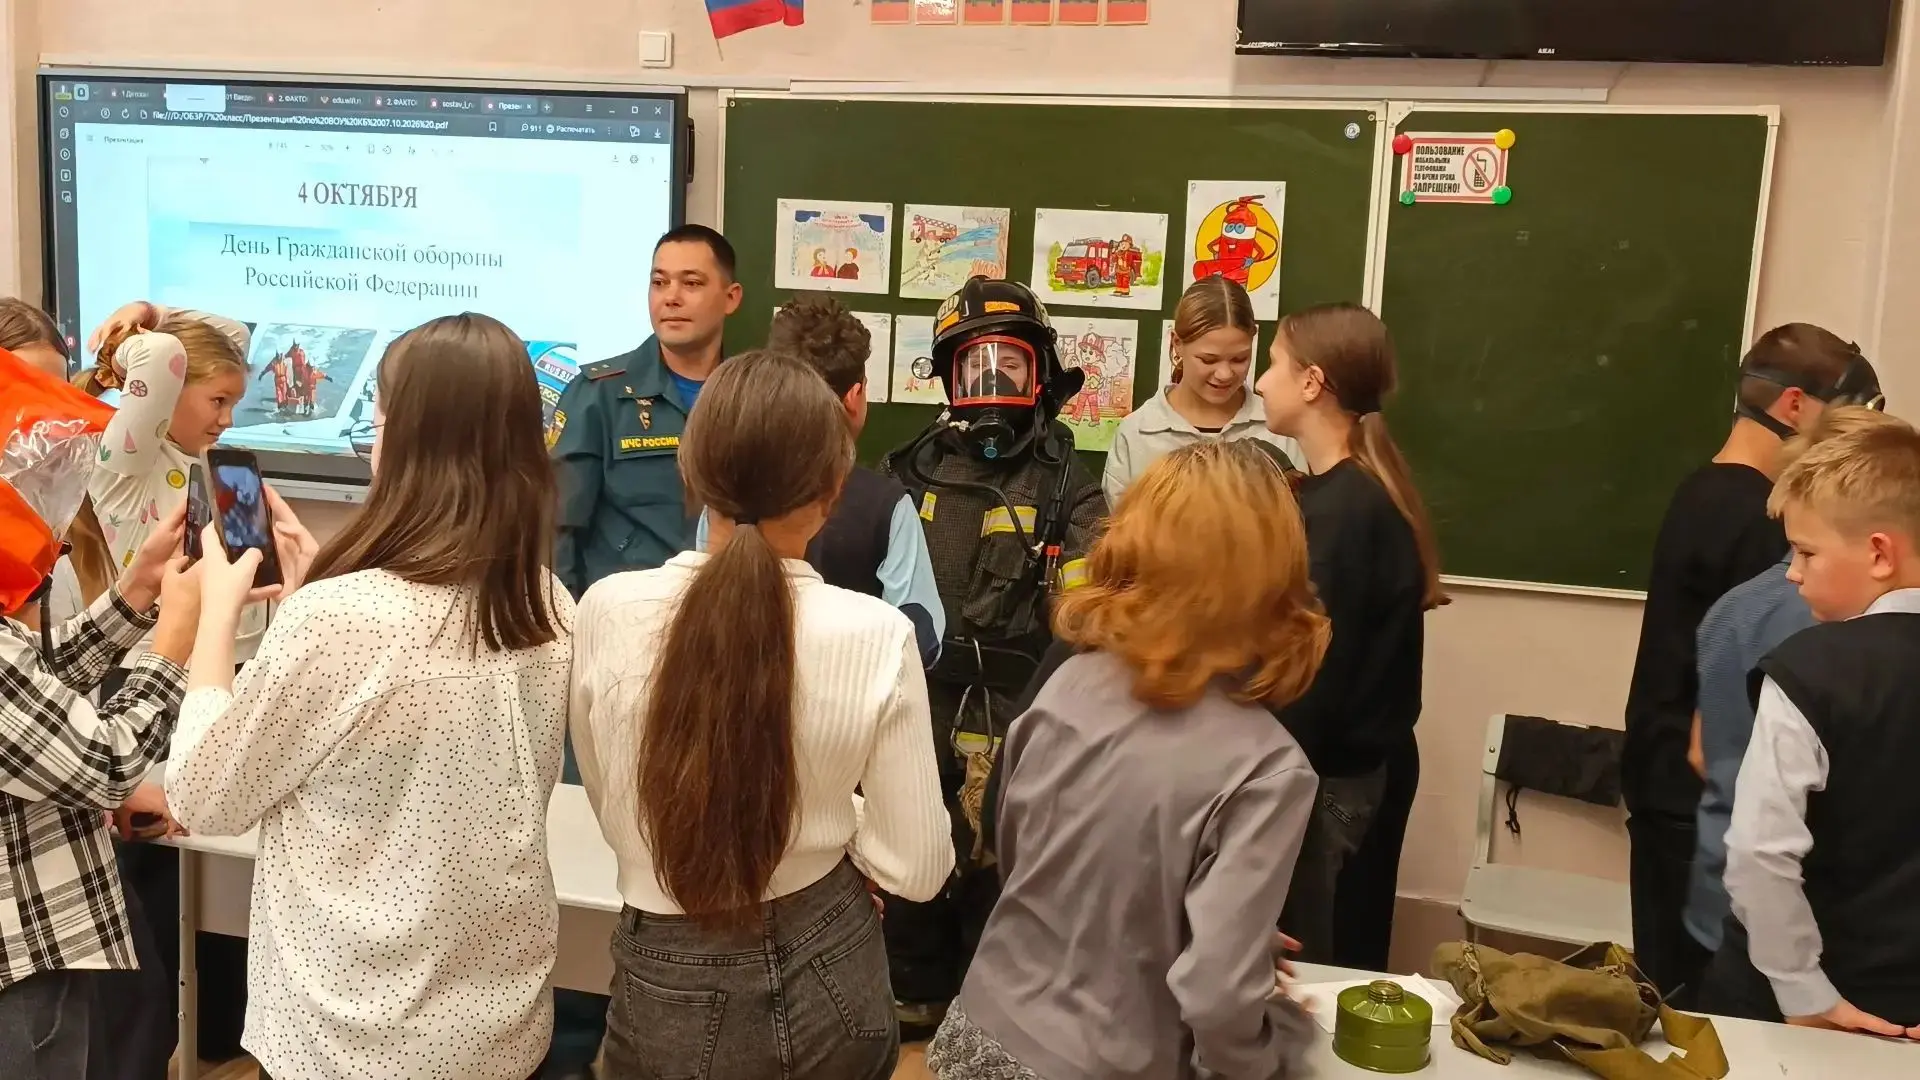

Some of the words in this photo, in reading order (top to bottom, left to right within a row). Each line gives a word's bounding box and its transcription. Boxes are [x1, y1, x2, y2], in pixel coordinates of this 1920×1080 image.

[556, 126, 596, 134] Распечатать
[1415, 145, 1464, 156] ПОЛЬЗОВАНИЕ
[1422, 173, 1438, 181] ВРЕМЯ
[1413, 182, 1460, 194] ЗАПРЕЩЕНО!
[298, 182, 308, 203] 4
[313, 181, 418, 209] ОКТЯБРЯ
[220, 233, 270, 256] День
[277, 236, 407, 262] Гражданской
[413, 244, 503, 270] обороны
[245, 267, 358, 292] Российской
[366, 273, 479, 301] Федерации
[620, 438, 641, 449] МЧС
[642, 436, 680, 447] РОССИИ
